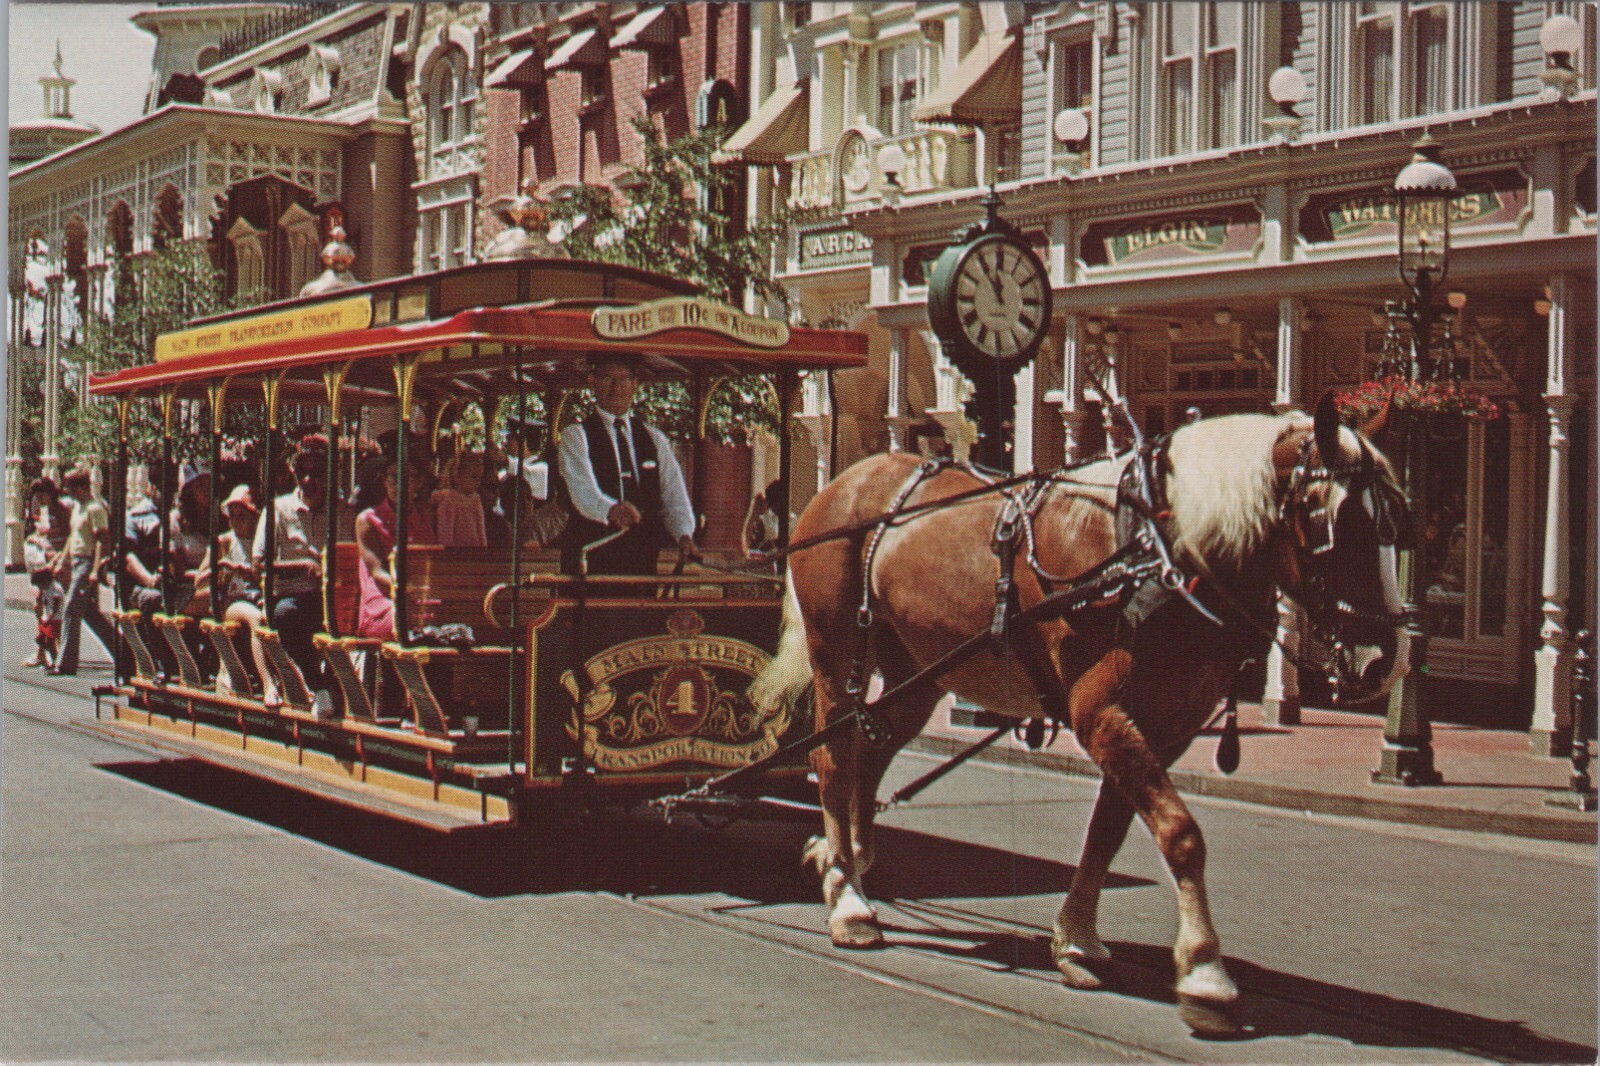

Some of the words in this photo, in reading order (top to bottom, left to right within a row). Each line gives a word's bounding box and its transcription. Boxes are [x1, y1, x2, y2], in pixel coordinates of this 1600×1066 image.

[1126, 219, 1209, 254] ELGIN
[196, 332, 222, 348] STREET
[229, 319, 294, 343] TRANSPORTATION
[301, 311, 342, 331] COMPANY
[607, 311, 650, 333] FARE
[740, 319, 778, 340] COUPON
[601, 643, 666, 674] MAIN
[679, 642, 761, 669] STREET
[665, 680, 699, 715] 4
[593, 737, 747, 768] TRANSPORTATION
